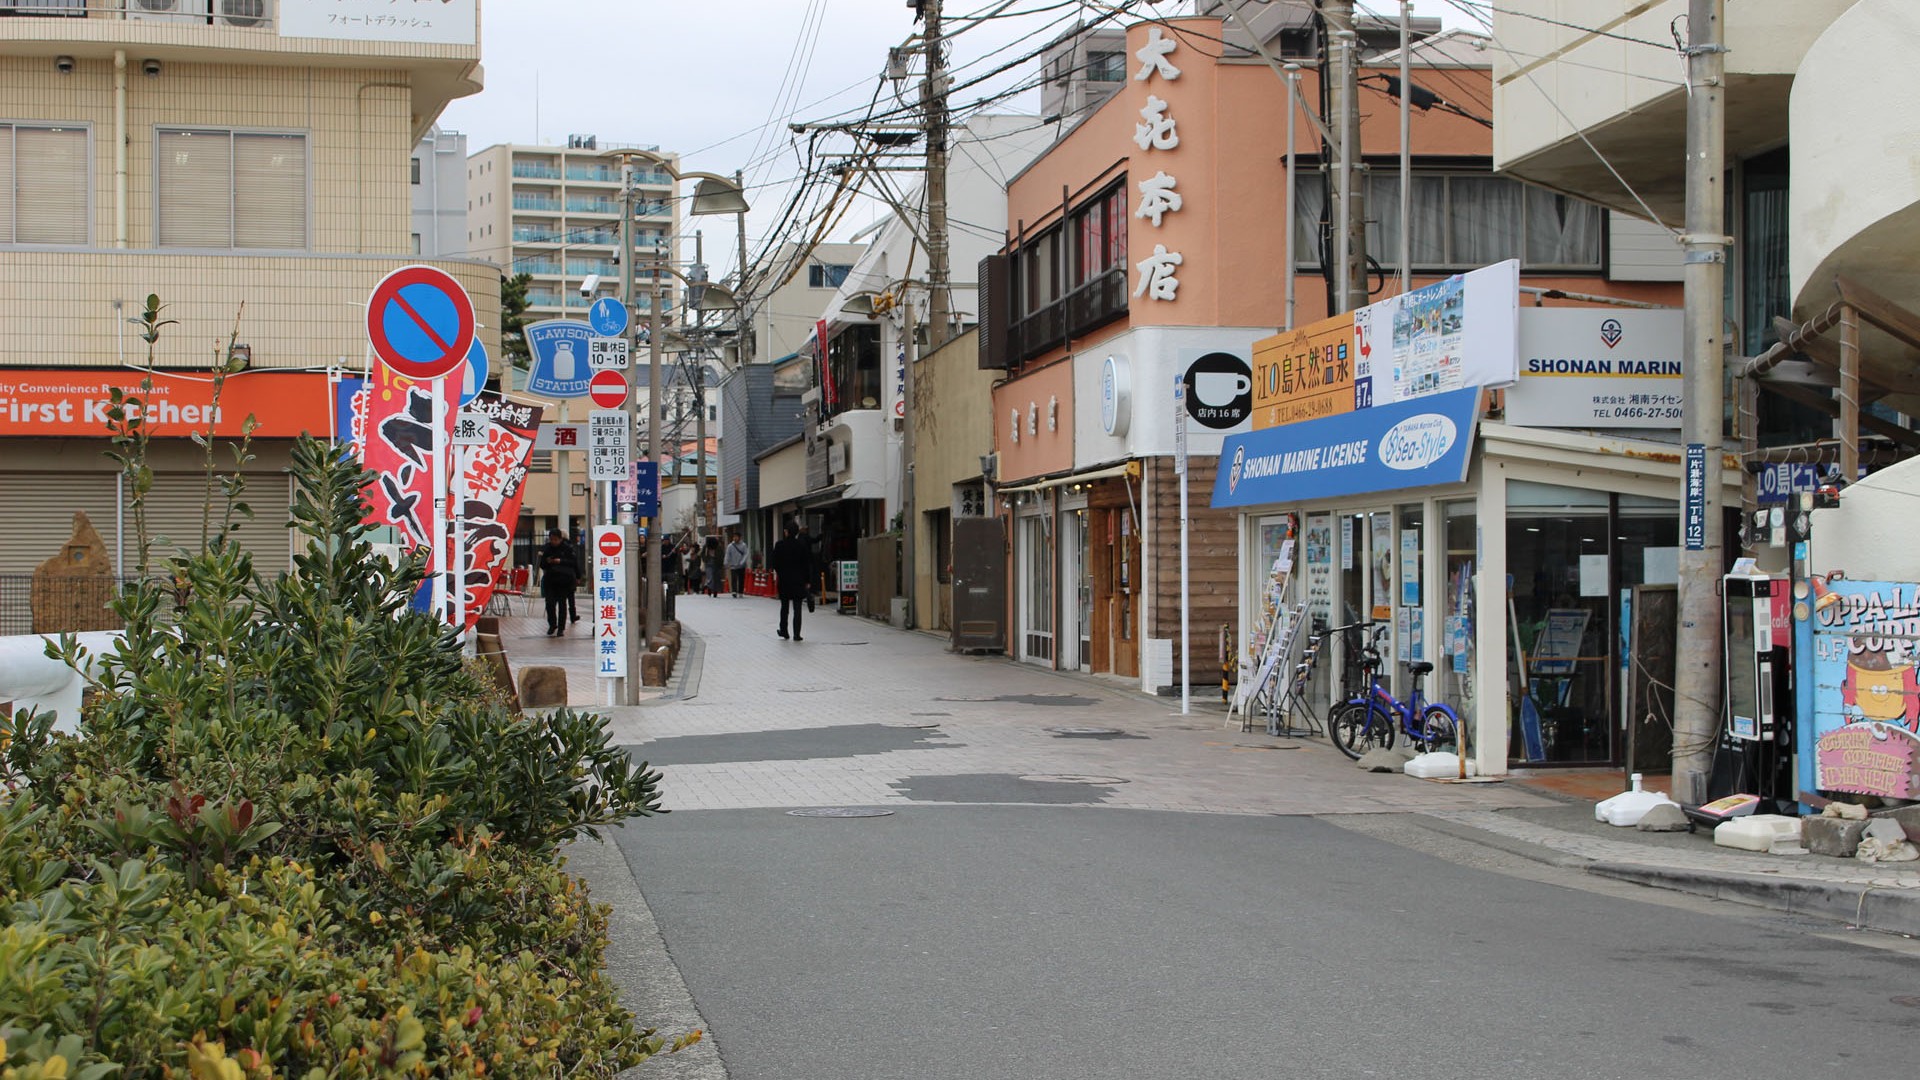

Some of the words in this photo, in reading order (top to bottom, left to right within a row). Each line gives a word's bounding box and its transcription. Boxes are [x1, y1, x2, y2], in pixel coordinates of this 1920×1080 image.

[535, 328, 593, 341] LAWSON
[1257, 339, 1349, 400] 江の島天然温泉
[1528, 358, 1611, 374] SHONAN
[1618, 360, 1682, 375] MARIN
[0, 383, 16, 395] ity
[19, 382, 98, 394] Convenience
[101, 383, 170, 394] Rstauant
[1592, 395, 1626, 405] 株式会社
[1593, 409, 1611, 418] TEL
[555, 428, 577, 446] 酒
[1396, 426, 1447, 469] Sea-Style
[1243, 454, 1281, 479] SHONAN
[1281, 448, 1321, 474] MARINE
[1321, 440, 1368, 469] LICENSE
[1688, 525, 1702, 537] 12
[1816, 638, 1846, 663] 4F
[1821, 732, 1873, 752] CURRY
